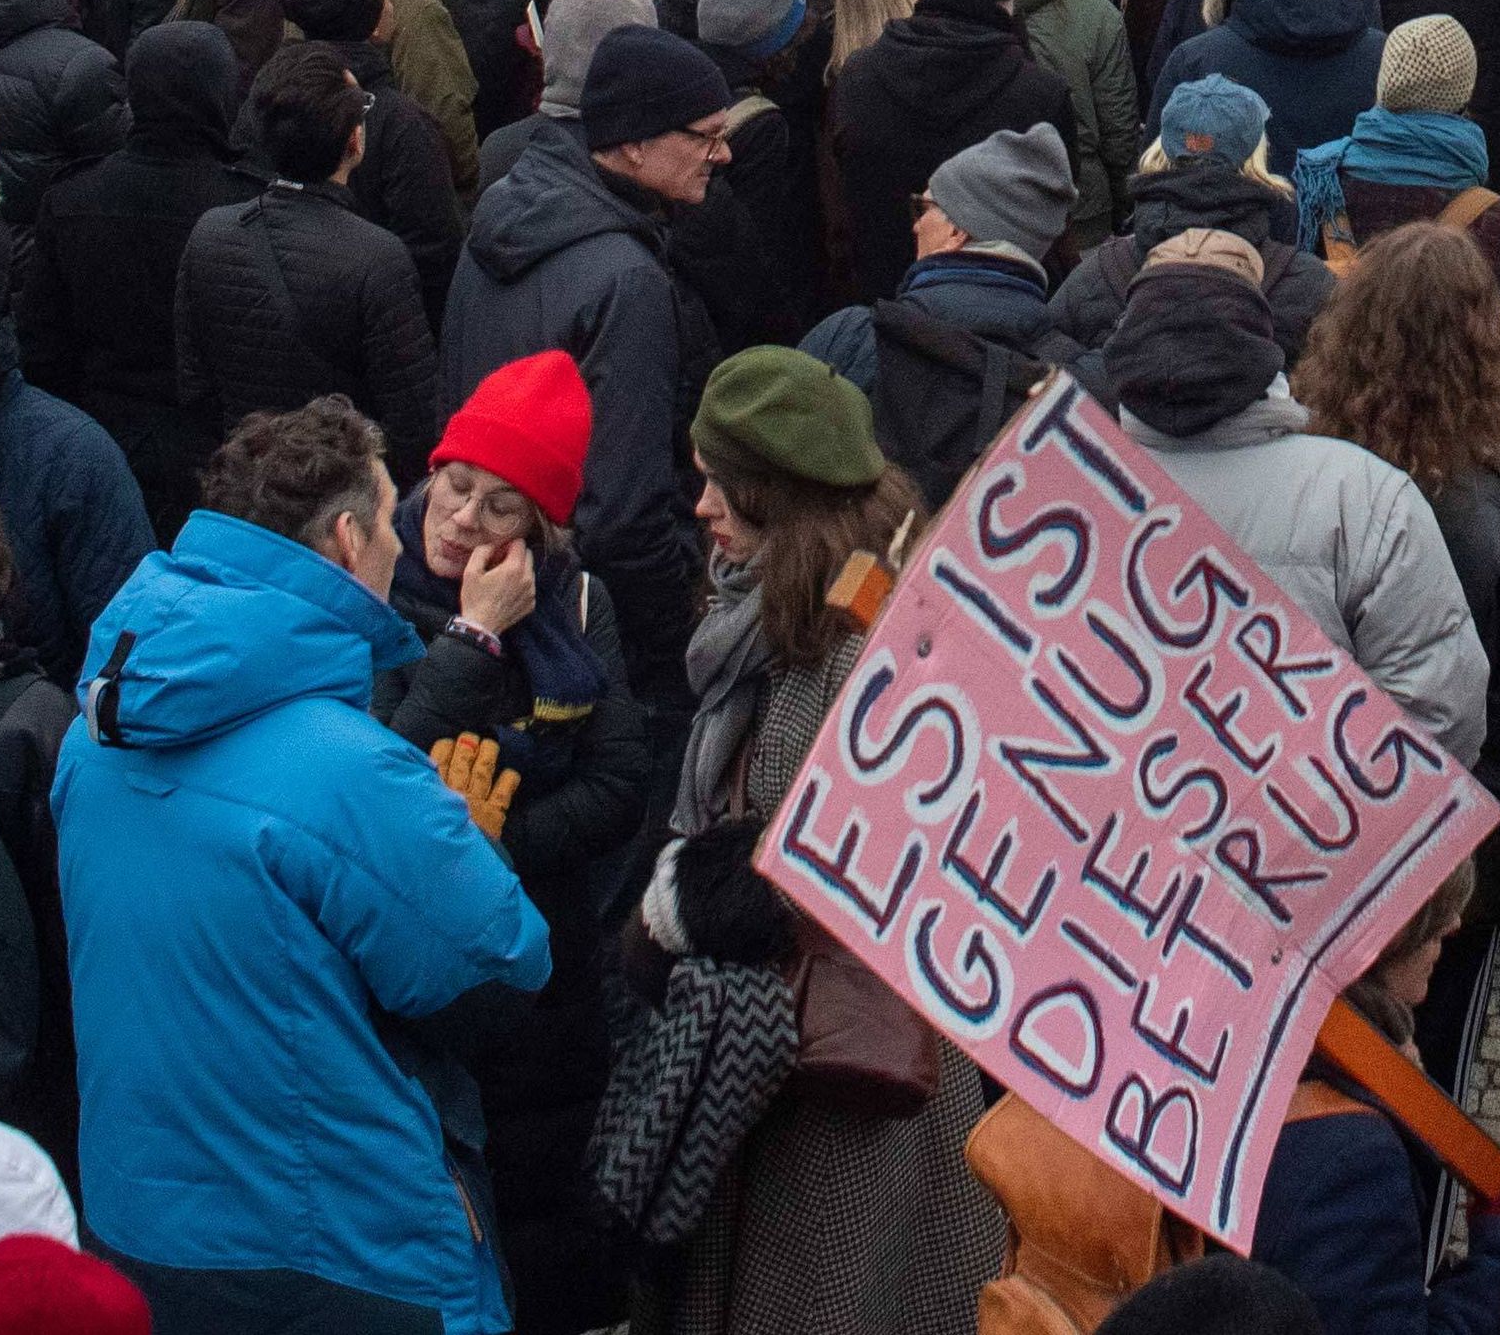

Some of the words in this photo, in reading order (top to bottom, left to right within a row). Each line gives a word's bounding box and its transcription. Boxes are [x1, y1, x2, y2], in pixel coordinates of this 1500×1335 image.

[782, 660, 970, 941] ES
[929, 390, 1152, 654] IST
[907, 509, 1252, 1035] GENUG
[1104, 688, 1445, 1200] BETRUG
